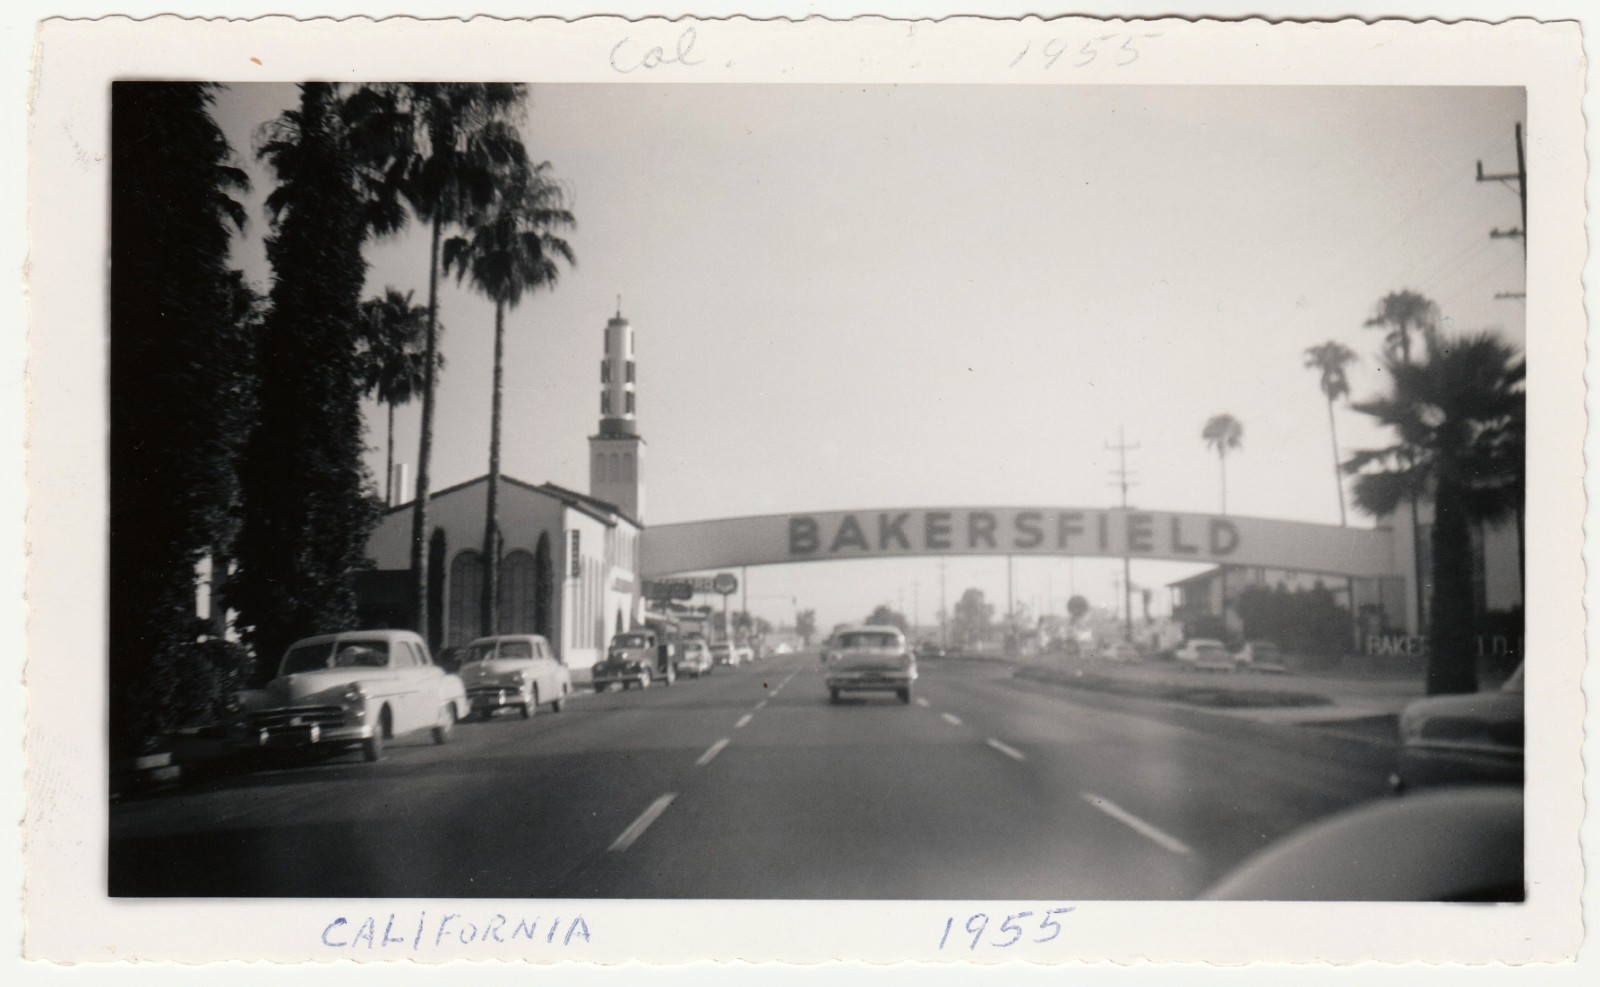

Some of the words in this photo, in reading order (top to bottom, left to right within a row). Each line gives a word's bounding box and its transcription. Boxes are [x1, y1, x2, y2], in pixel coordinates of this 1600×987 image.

[1009, 33, 1164, 69] 1955
[788, 510, 1241, 556] BAKERSFIELD
[322, 912, 592, 949] CALIFORNIA
[940, 907, 1074, 950] 1955
